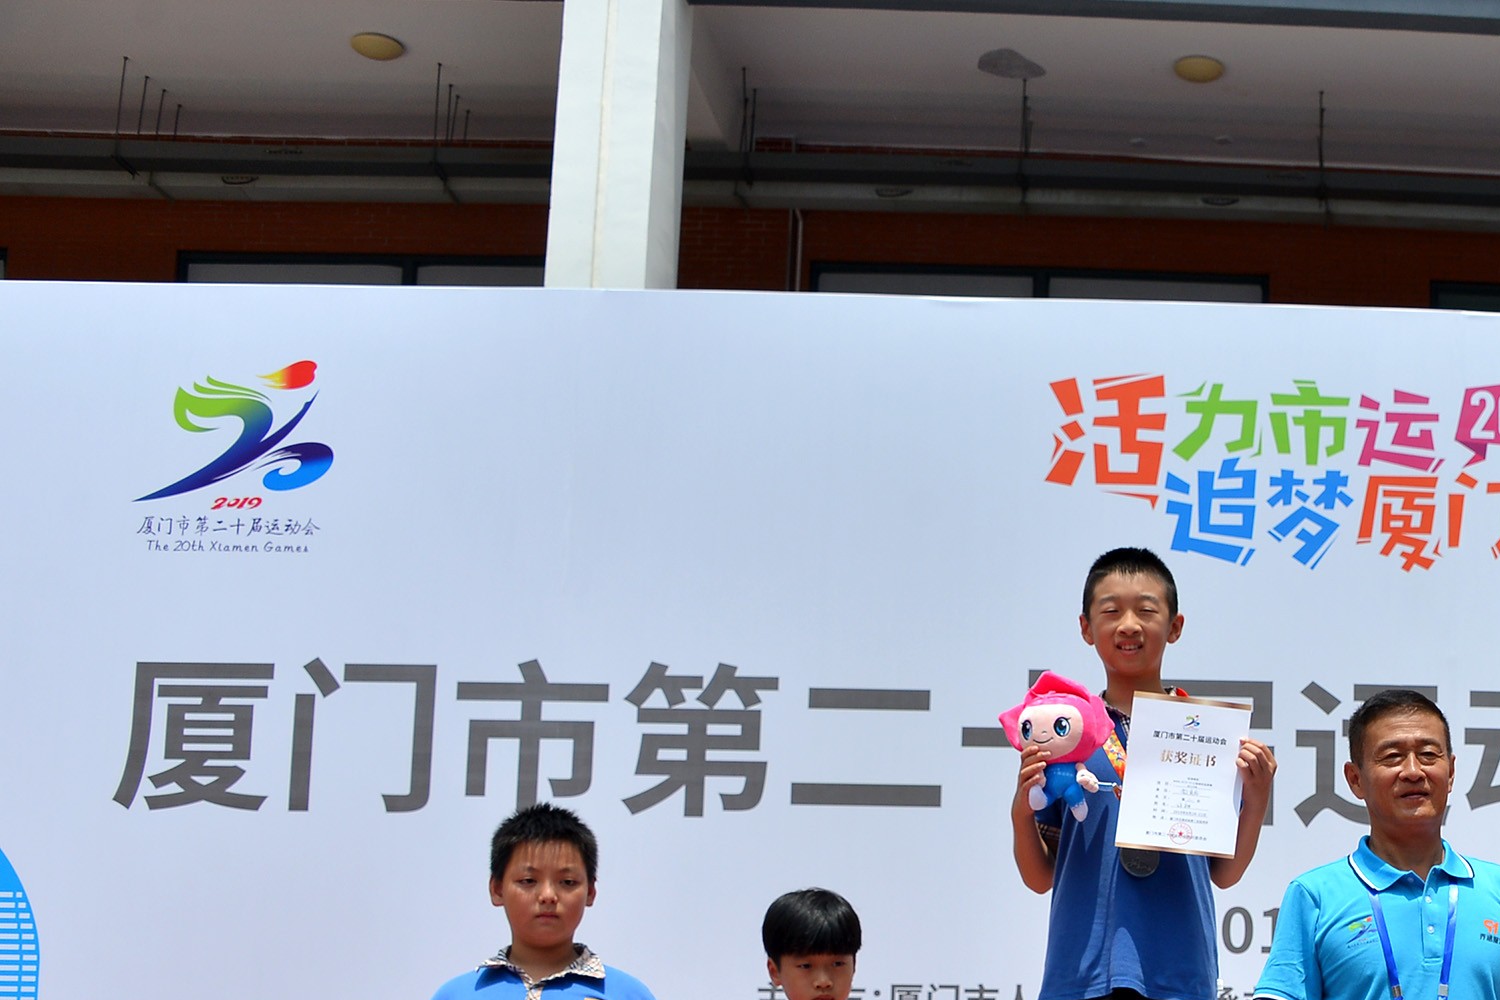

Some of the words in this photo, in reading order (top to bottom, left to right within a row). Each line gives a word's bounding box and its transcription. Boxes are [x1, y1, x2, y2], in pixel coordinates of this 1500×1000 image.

[1045, 374, 1446, 498] 活力市运
[210, 496, 263, 510] 2019
[137, 515, 321, 537] 厦门市第二十届运动会
[147, 540, 169, 552] The
[173, 540, 205, 553] 20th
[263, 541, 310, 554] Games
